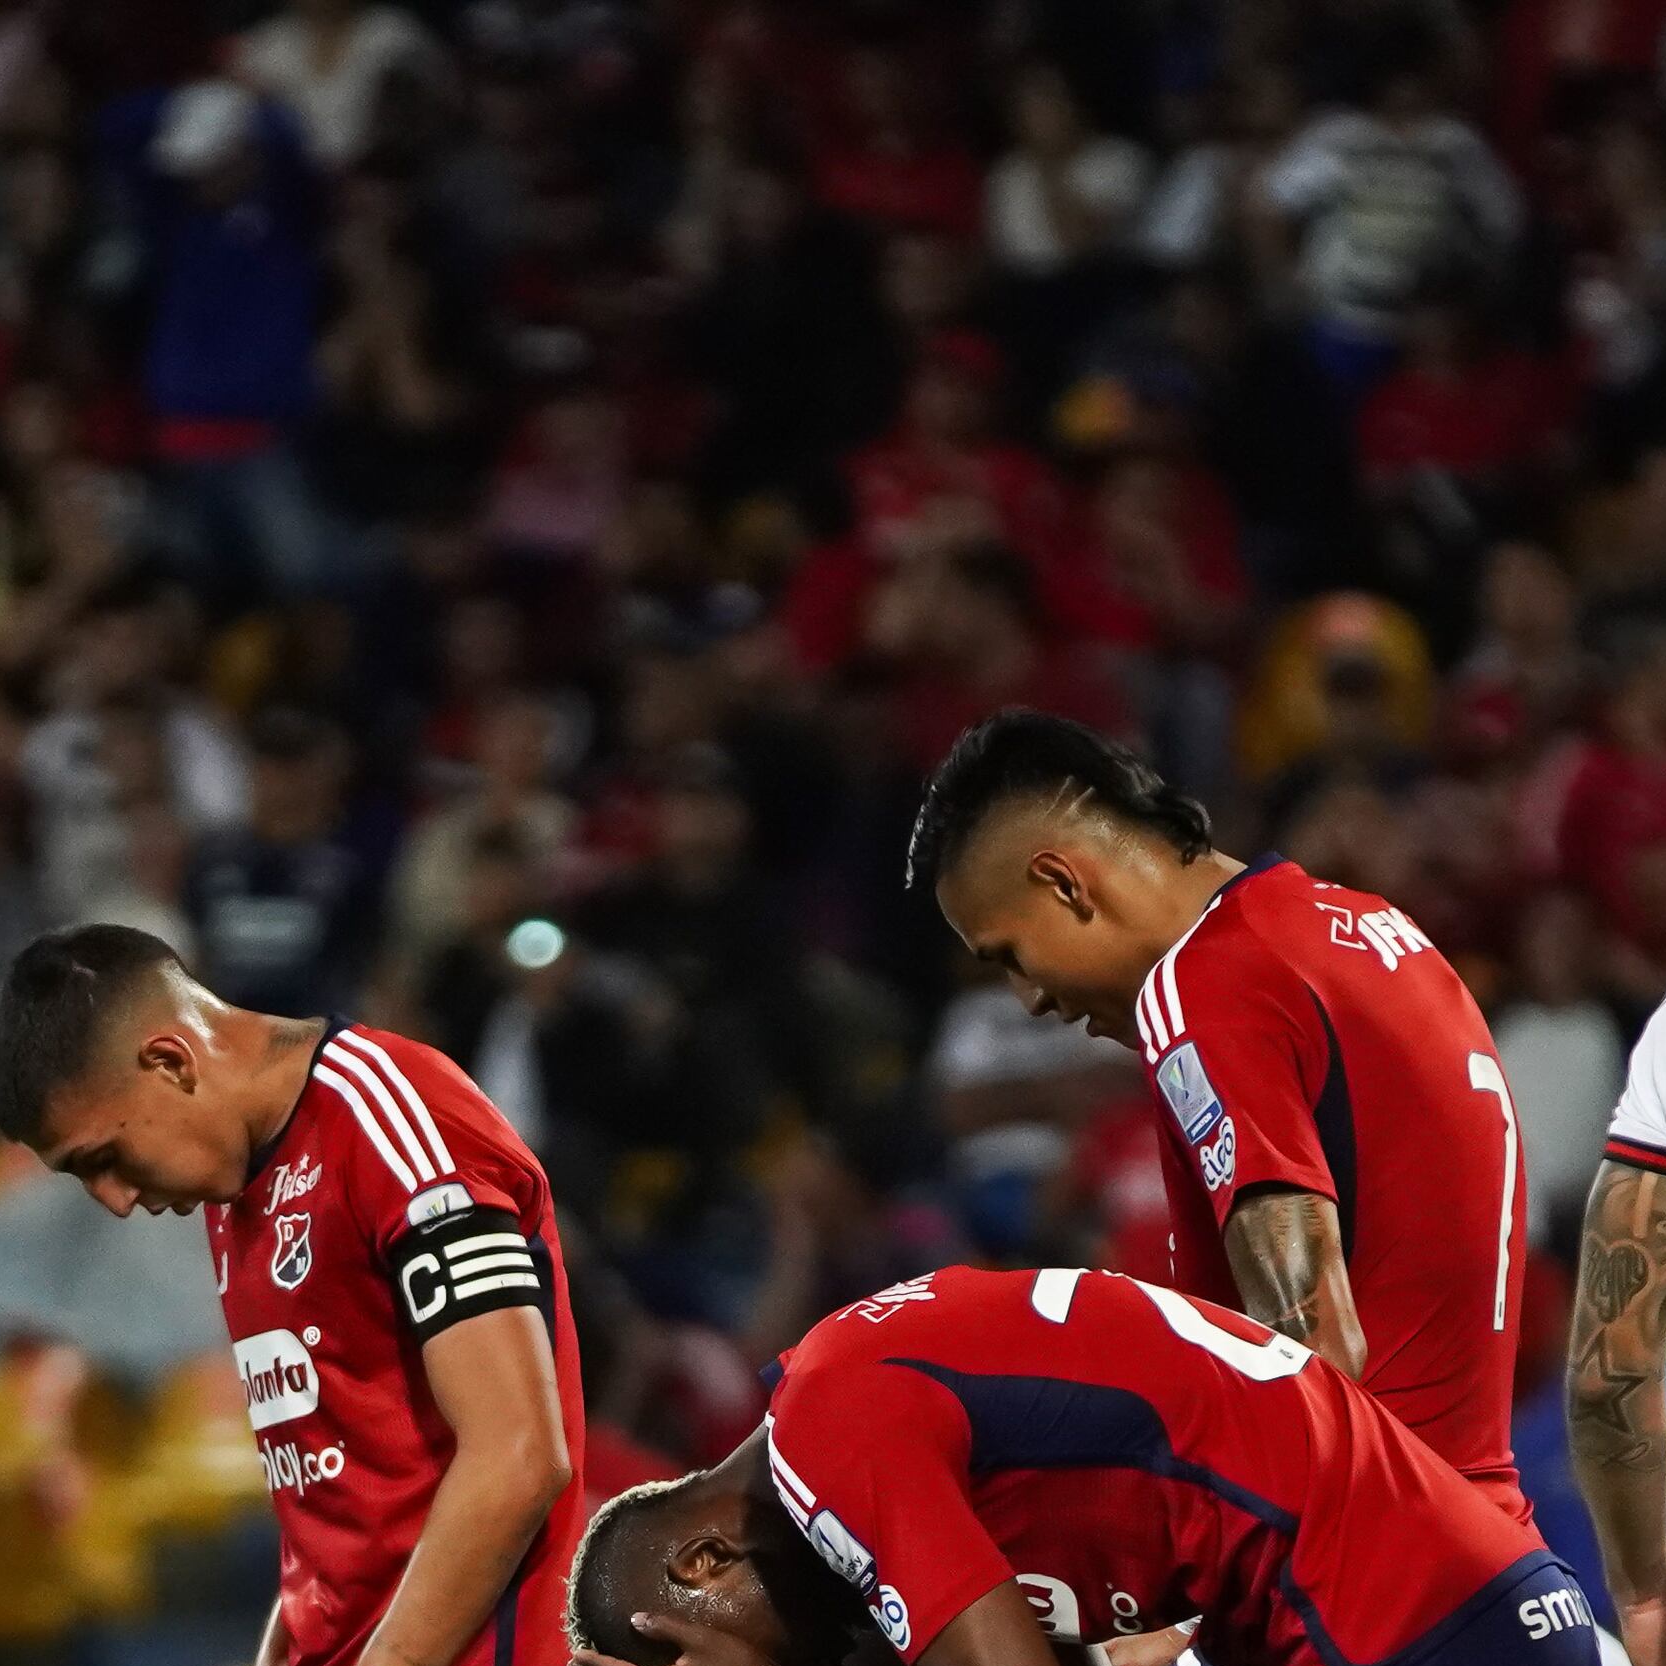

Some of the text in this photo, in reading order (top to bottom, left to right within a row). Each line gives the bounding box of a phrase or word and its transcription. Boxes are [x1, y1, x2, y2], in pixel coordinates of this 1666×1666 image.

[1468, 1052, 1518, 1332] 7
[401, 1252, 447, 1323] C
[241, 1355, 310, 1409] lanta
